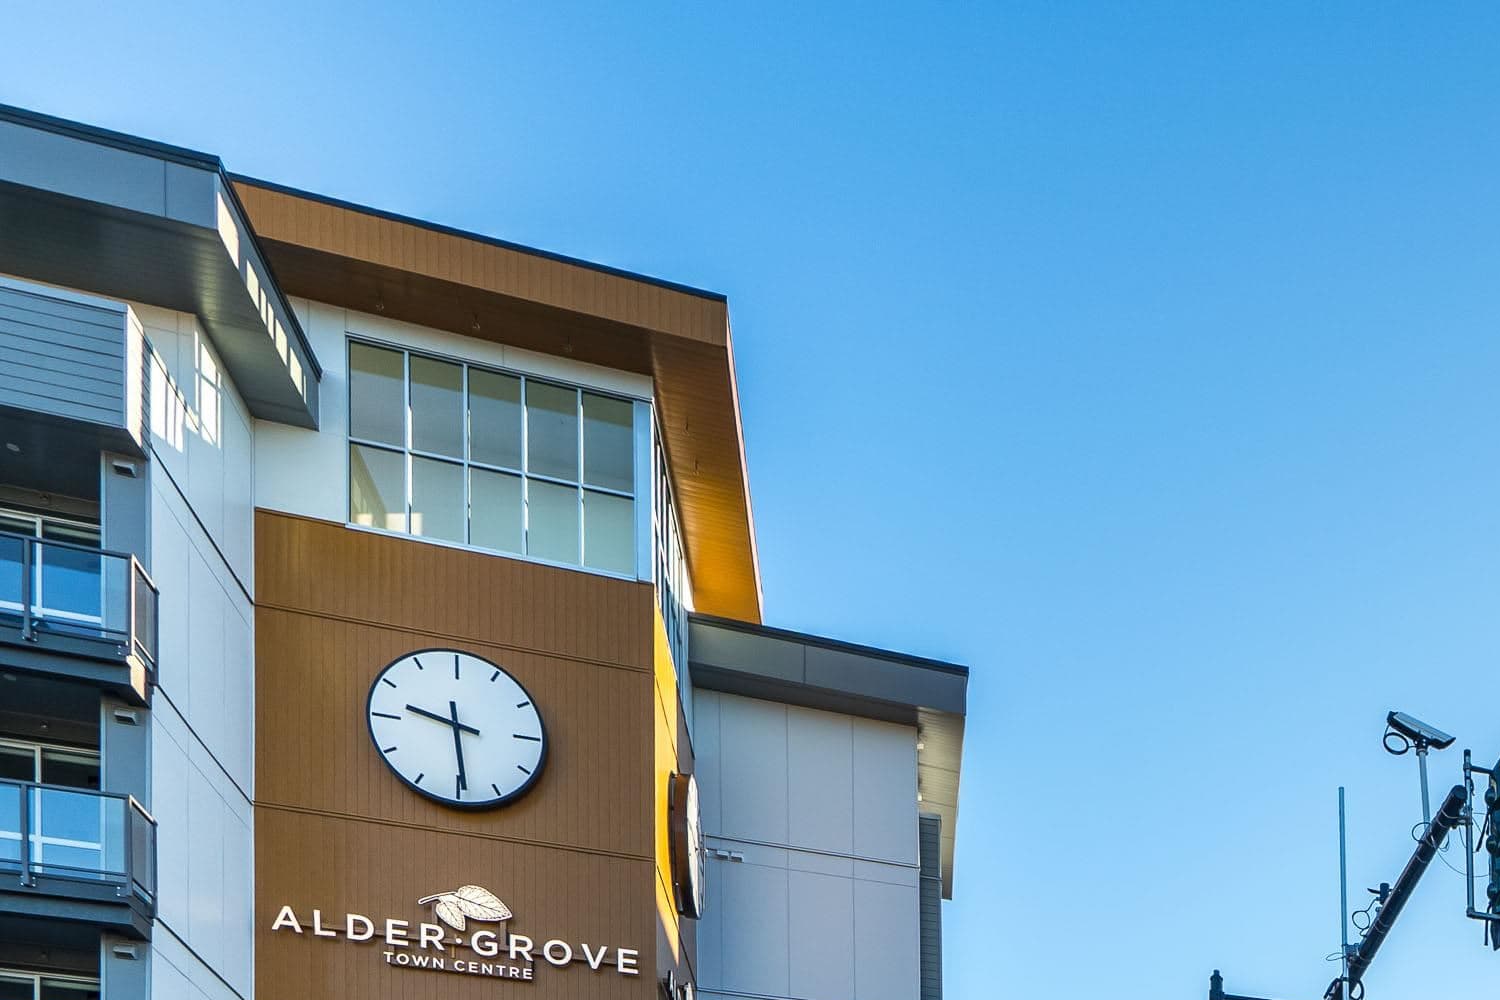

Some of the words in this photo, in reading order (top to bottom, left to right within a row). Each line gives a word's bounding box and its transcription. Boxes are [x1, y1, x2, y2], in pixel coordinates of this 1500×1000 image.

[271, 905, 446, 951] ALDER
[470, 929, 640, 975] GROVE
[383, 951, 445, 969] TOWN
[453, 960, 534, 980] CENTRE
